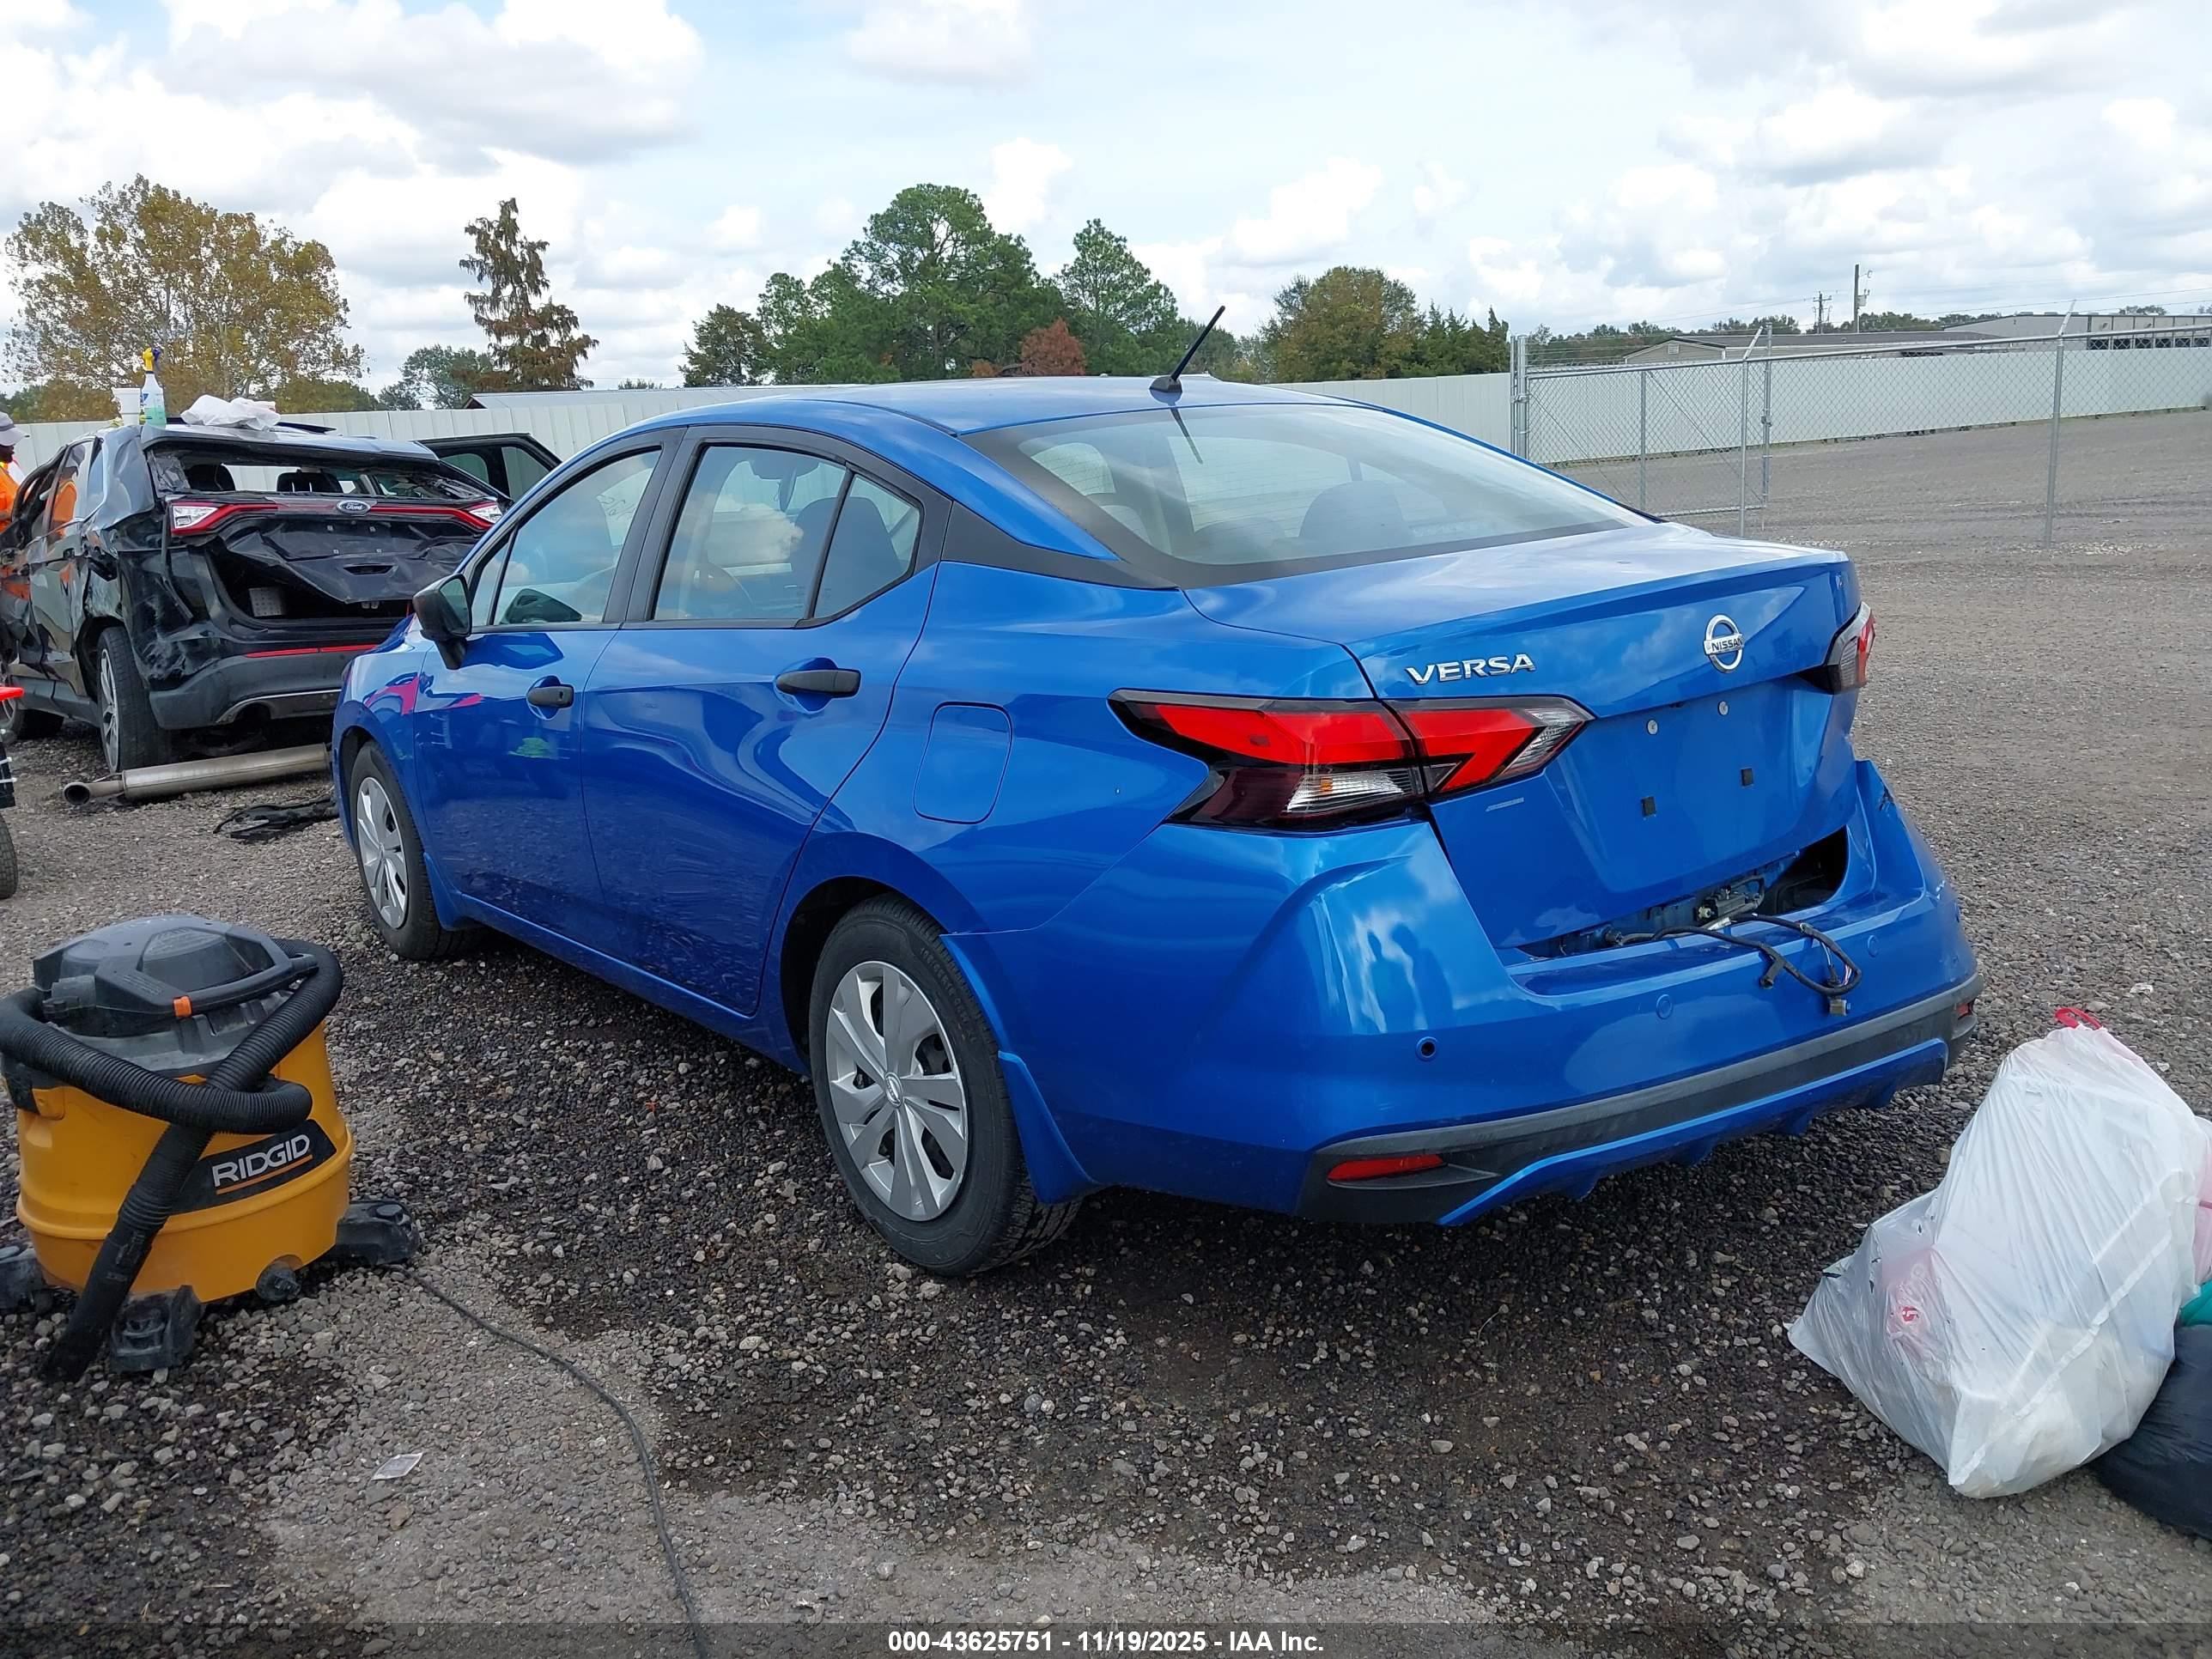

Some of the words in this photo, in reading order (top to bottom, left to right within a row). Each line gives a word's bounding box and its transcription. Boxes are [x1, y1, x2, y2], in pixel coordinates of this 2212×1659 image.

[1711, 637, 1743, 652] NISSAN
[1406, 653, 1535, 684] VERSA
[212, 1134, 310, 1187] RIDGID
